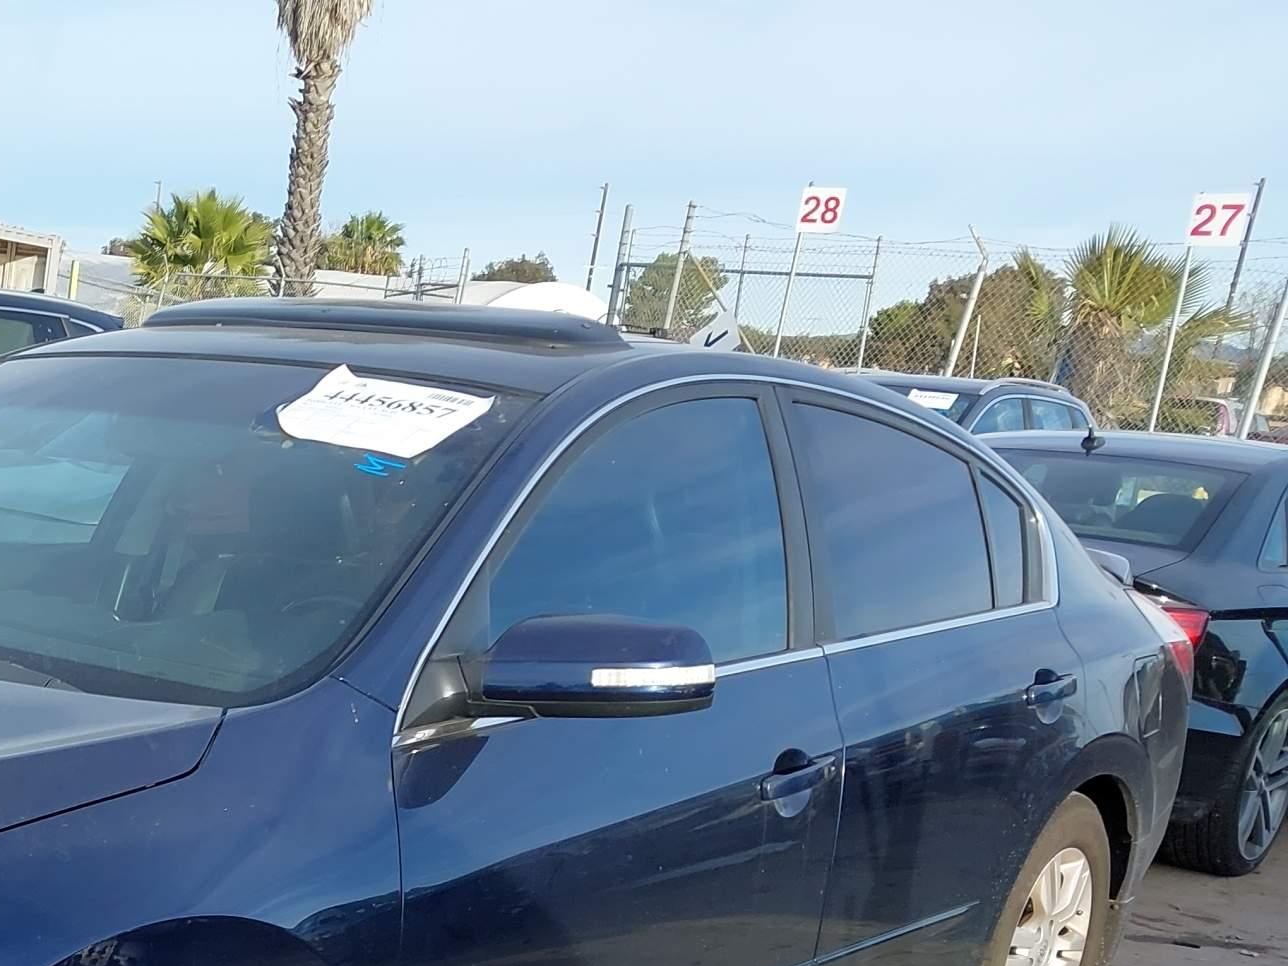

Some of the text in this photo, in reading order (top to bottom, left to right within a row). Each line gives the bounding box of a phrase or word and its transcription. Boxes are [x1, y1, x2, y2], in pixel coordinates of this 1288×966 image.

[801, 196, 840, 224] 28
[1190, 204, 1246, 236] 27
[324, 390, 457, 418] 44456857
